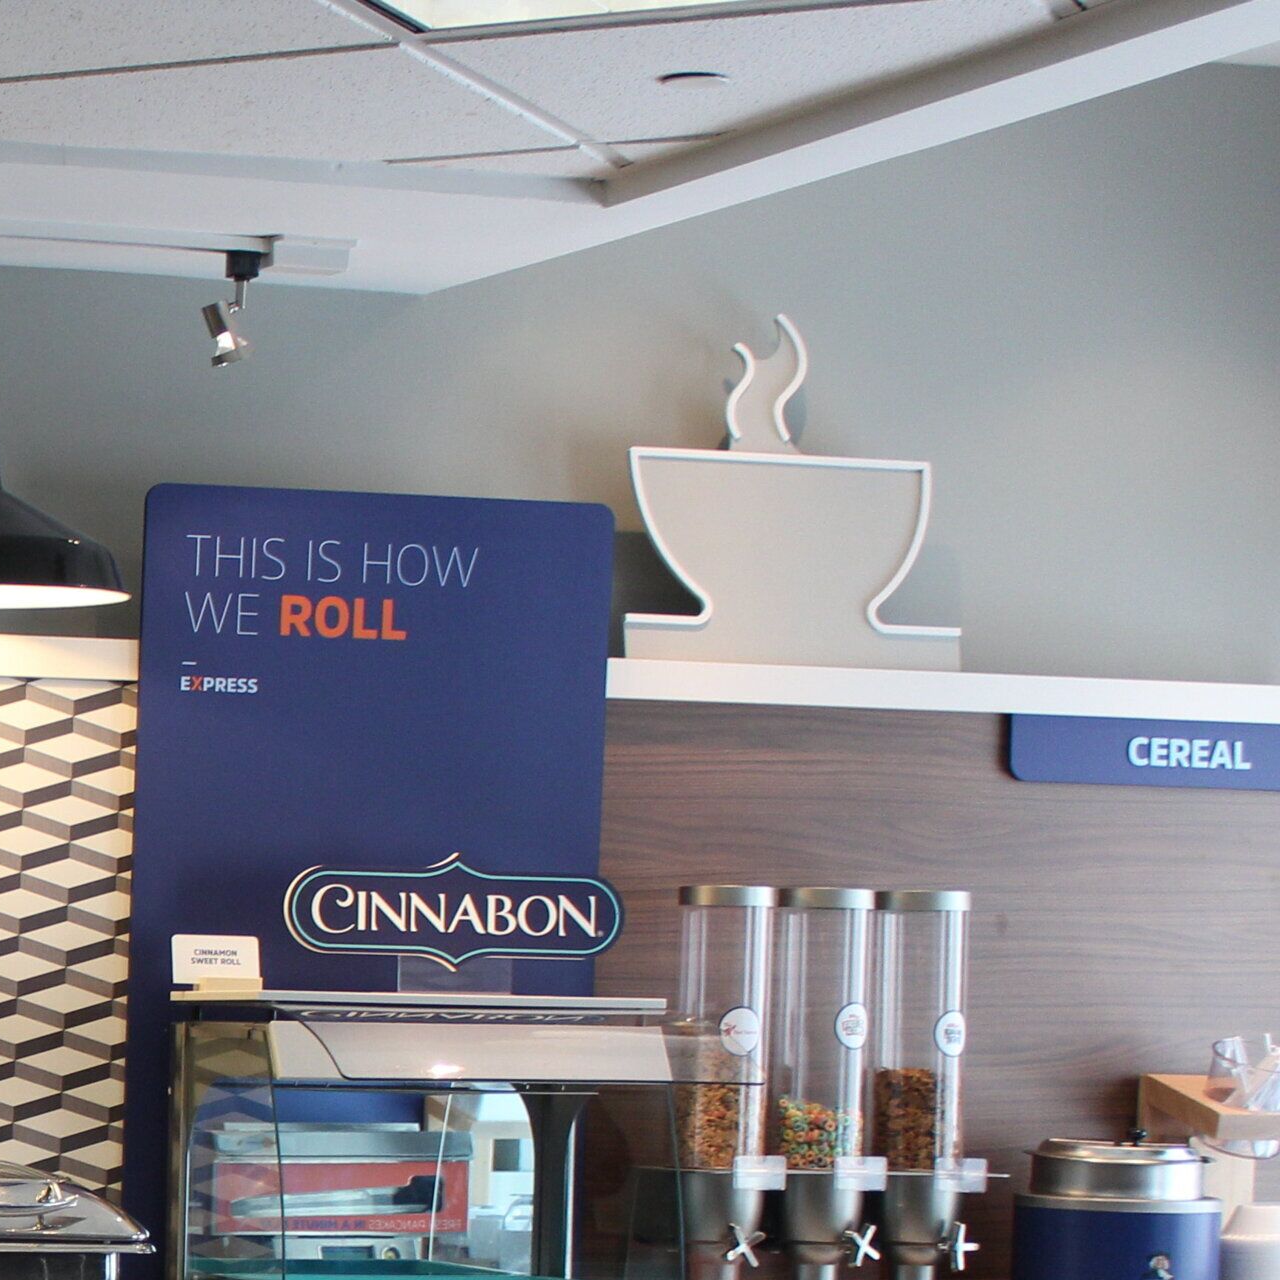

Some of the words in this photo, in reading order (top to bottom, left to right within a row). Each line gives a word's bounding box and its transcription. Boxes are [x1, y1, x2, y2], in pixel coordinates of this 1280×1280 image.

[185, 533, 287, 582] THIS
[307, 539, 342, 584] IS
[361, 542, 480, 589] HOW
[184, 590, 260, 637] WE
[278, 593, 408, 641] ROLL
[180, 674, 259, 694] EXPRESS
[1127, 735, 1252, 771] CEREAL
[310, 882, 598, 938] CINNABON
[191, 957, 218, 965] SWEET
[220, 957, 242, 966] ROLL
[193, 948, 238, 957] CINNAMON
